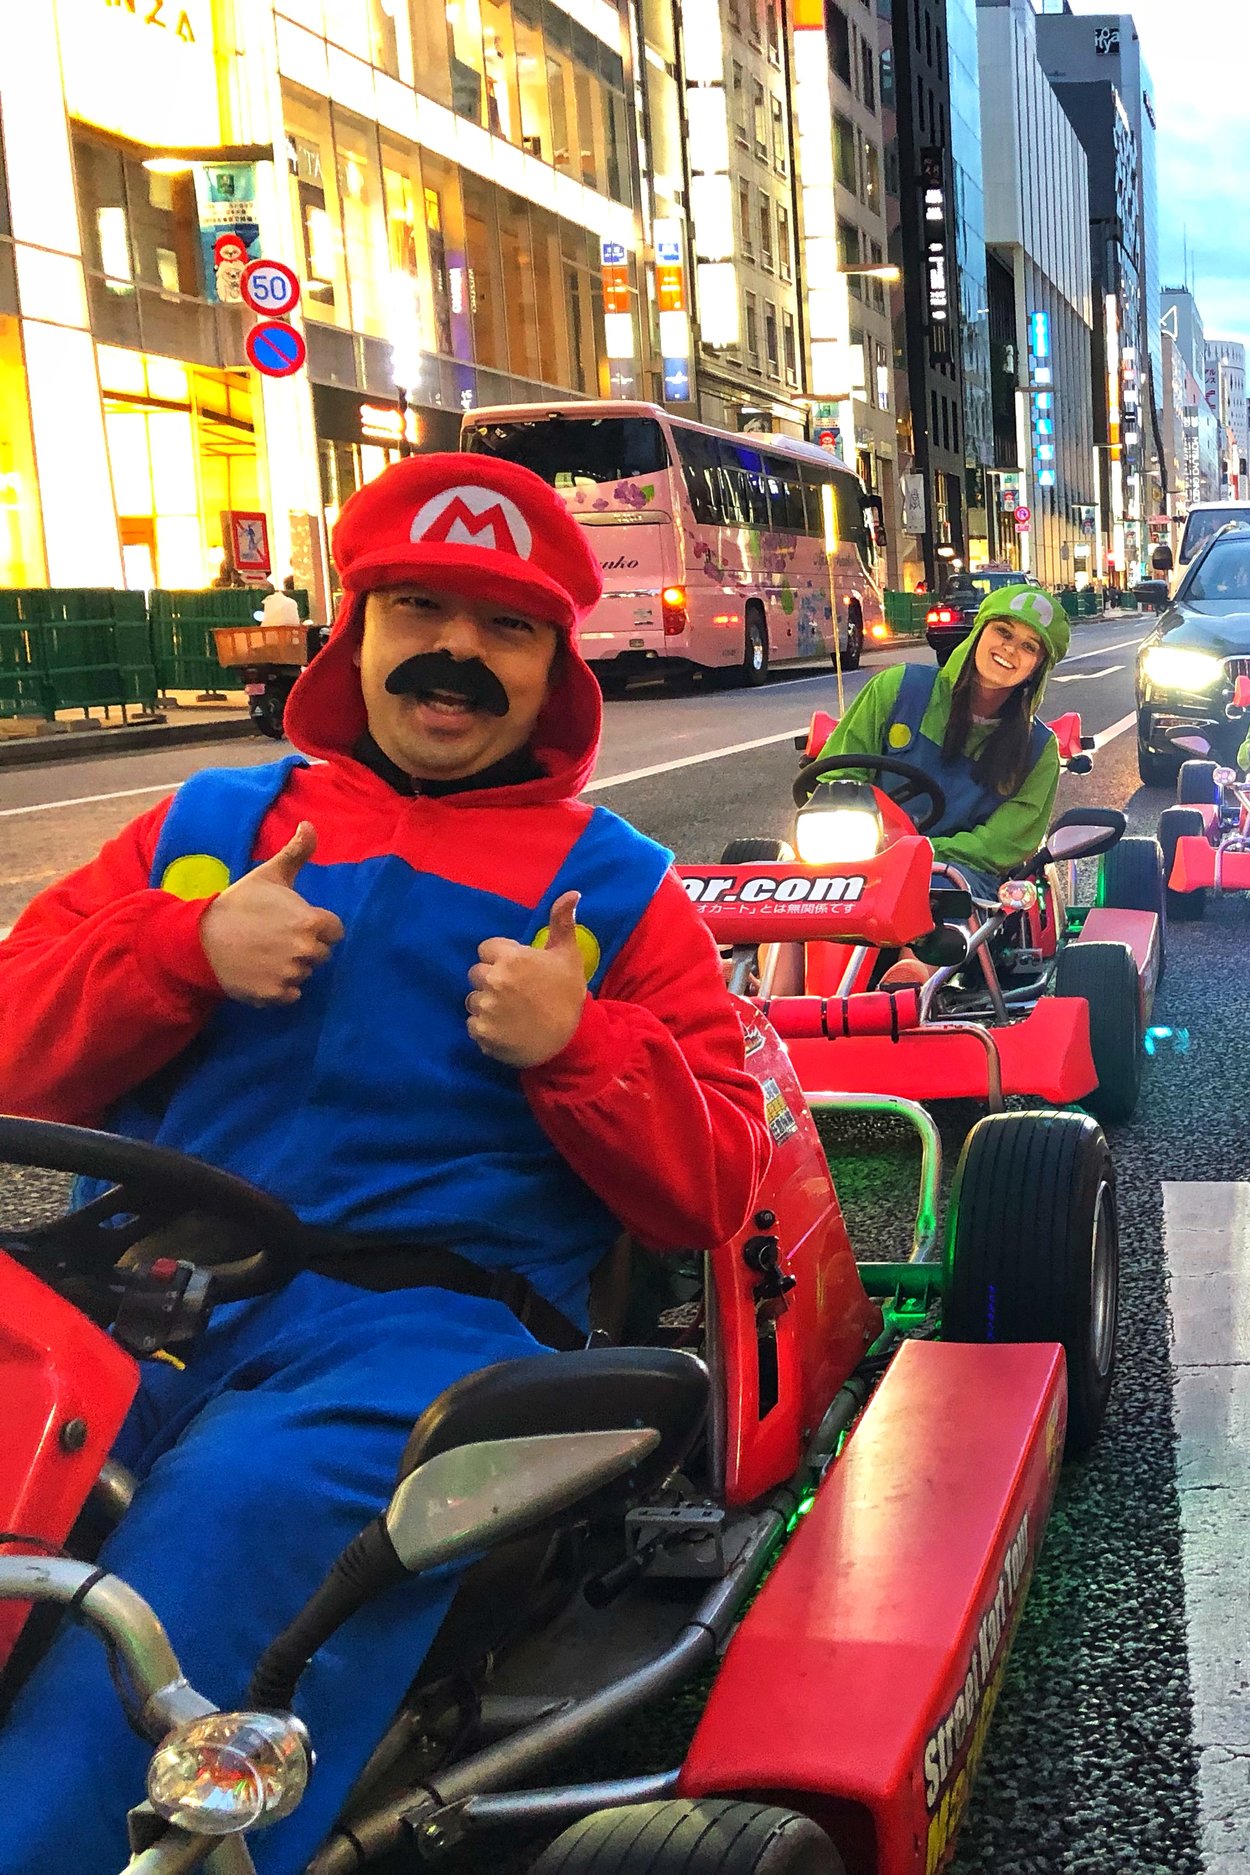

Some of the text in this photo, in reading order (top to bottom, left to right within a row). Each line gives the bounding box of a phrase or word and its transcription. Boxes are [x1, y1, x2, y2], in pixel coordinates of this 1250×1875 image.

[252, 275, 287, 301] 50
[419, 495, 520, 556] M
[925, 1650, 979, 1808] Street
